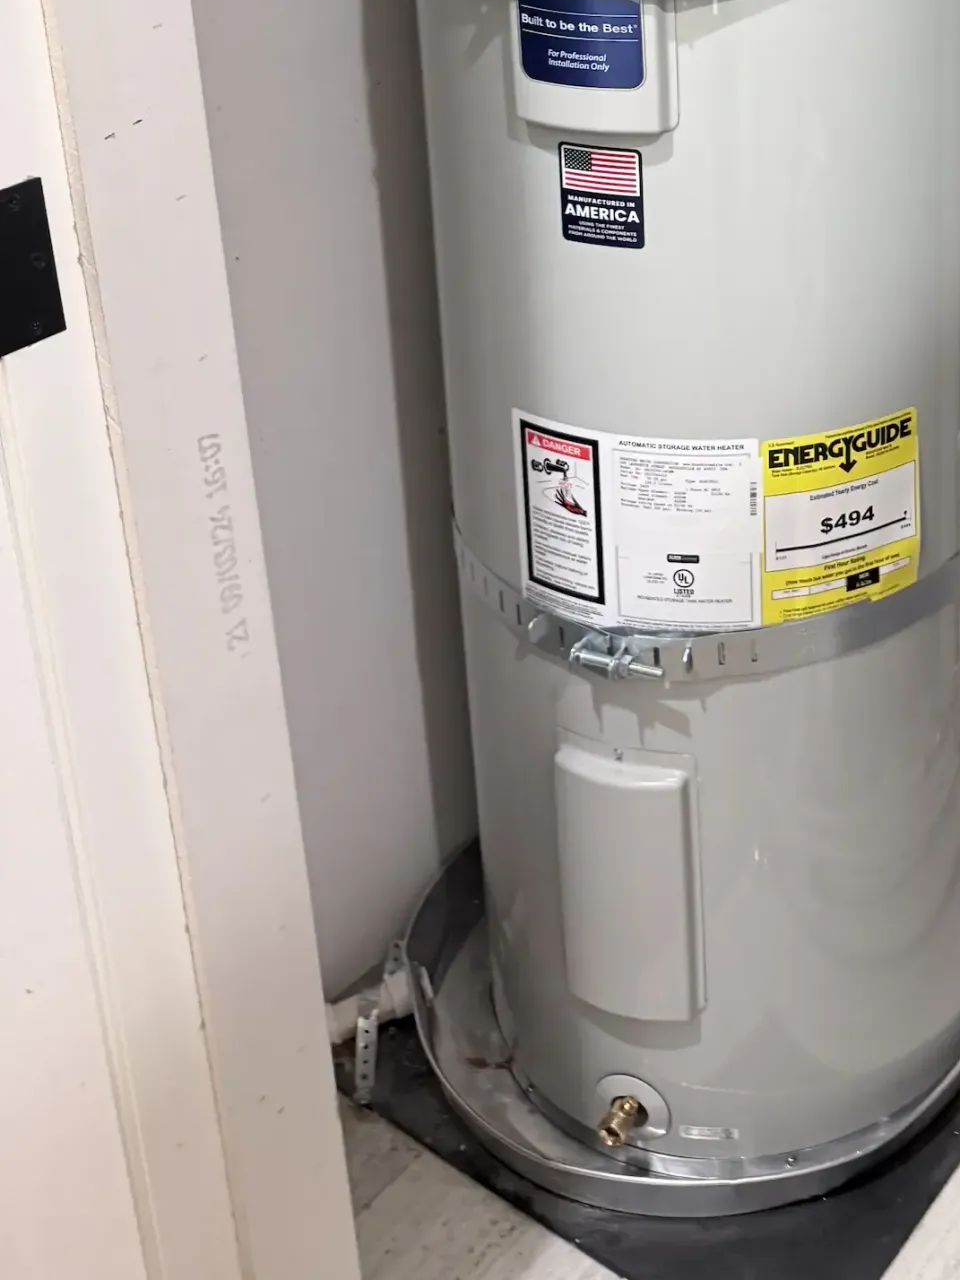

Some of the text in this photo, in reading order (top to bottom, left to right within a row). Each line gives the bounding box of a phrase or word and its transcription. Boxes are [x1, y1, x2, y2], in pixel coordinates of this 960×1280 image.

[521, 12, 544, 26] Built
[545, 18, 558, 30] to
[559, 19, 575, 32] be
[578, 21, 599, 34] the
[548, 48, 607, 62] For Professional
[548, 58, 610, 72] Installation Only
[567, 194, 625, 208] MANUFACTURED
[564, 202, 640, 224] AMERICA
[568, 224, 596, 233] MATERIALS
[601, 228, 637, 237] COMPONENTS
[583, 232, 606, 240] AROUND
[542, 439, 582, 457] DANGER
[619, 440, 656, 449] AUTOMATIC
[768, 417, 912, 473] ENERGYGUIDE
[810, 479, 879, 501] Estimated Yearly Energy Cost
[820, 505, 875, 534] $494
[836, 561, 849, 569] Hour
[850, 555, 866, 566] Rating
